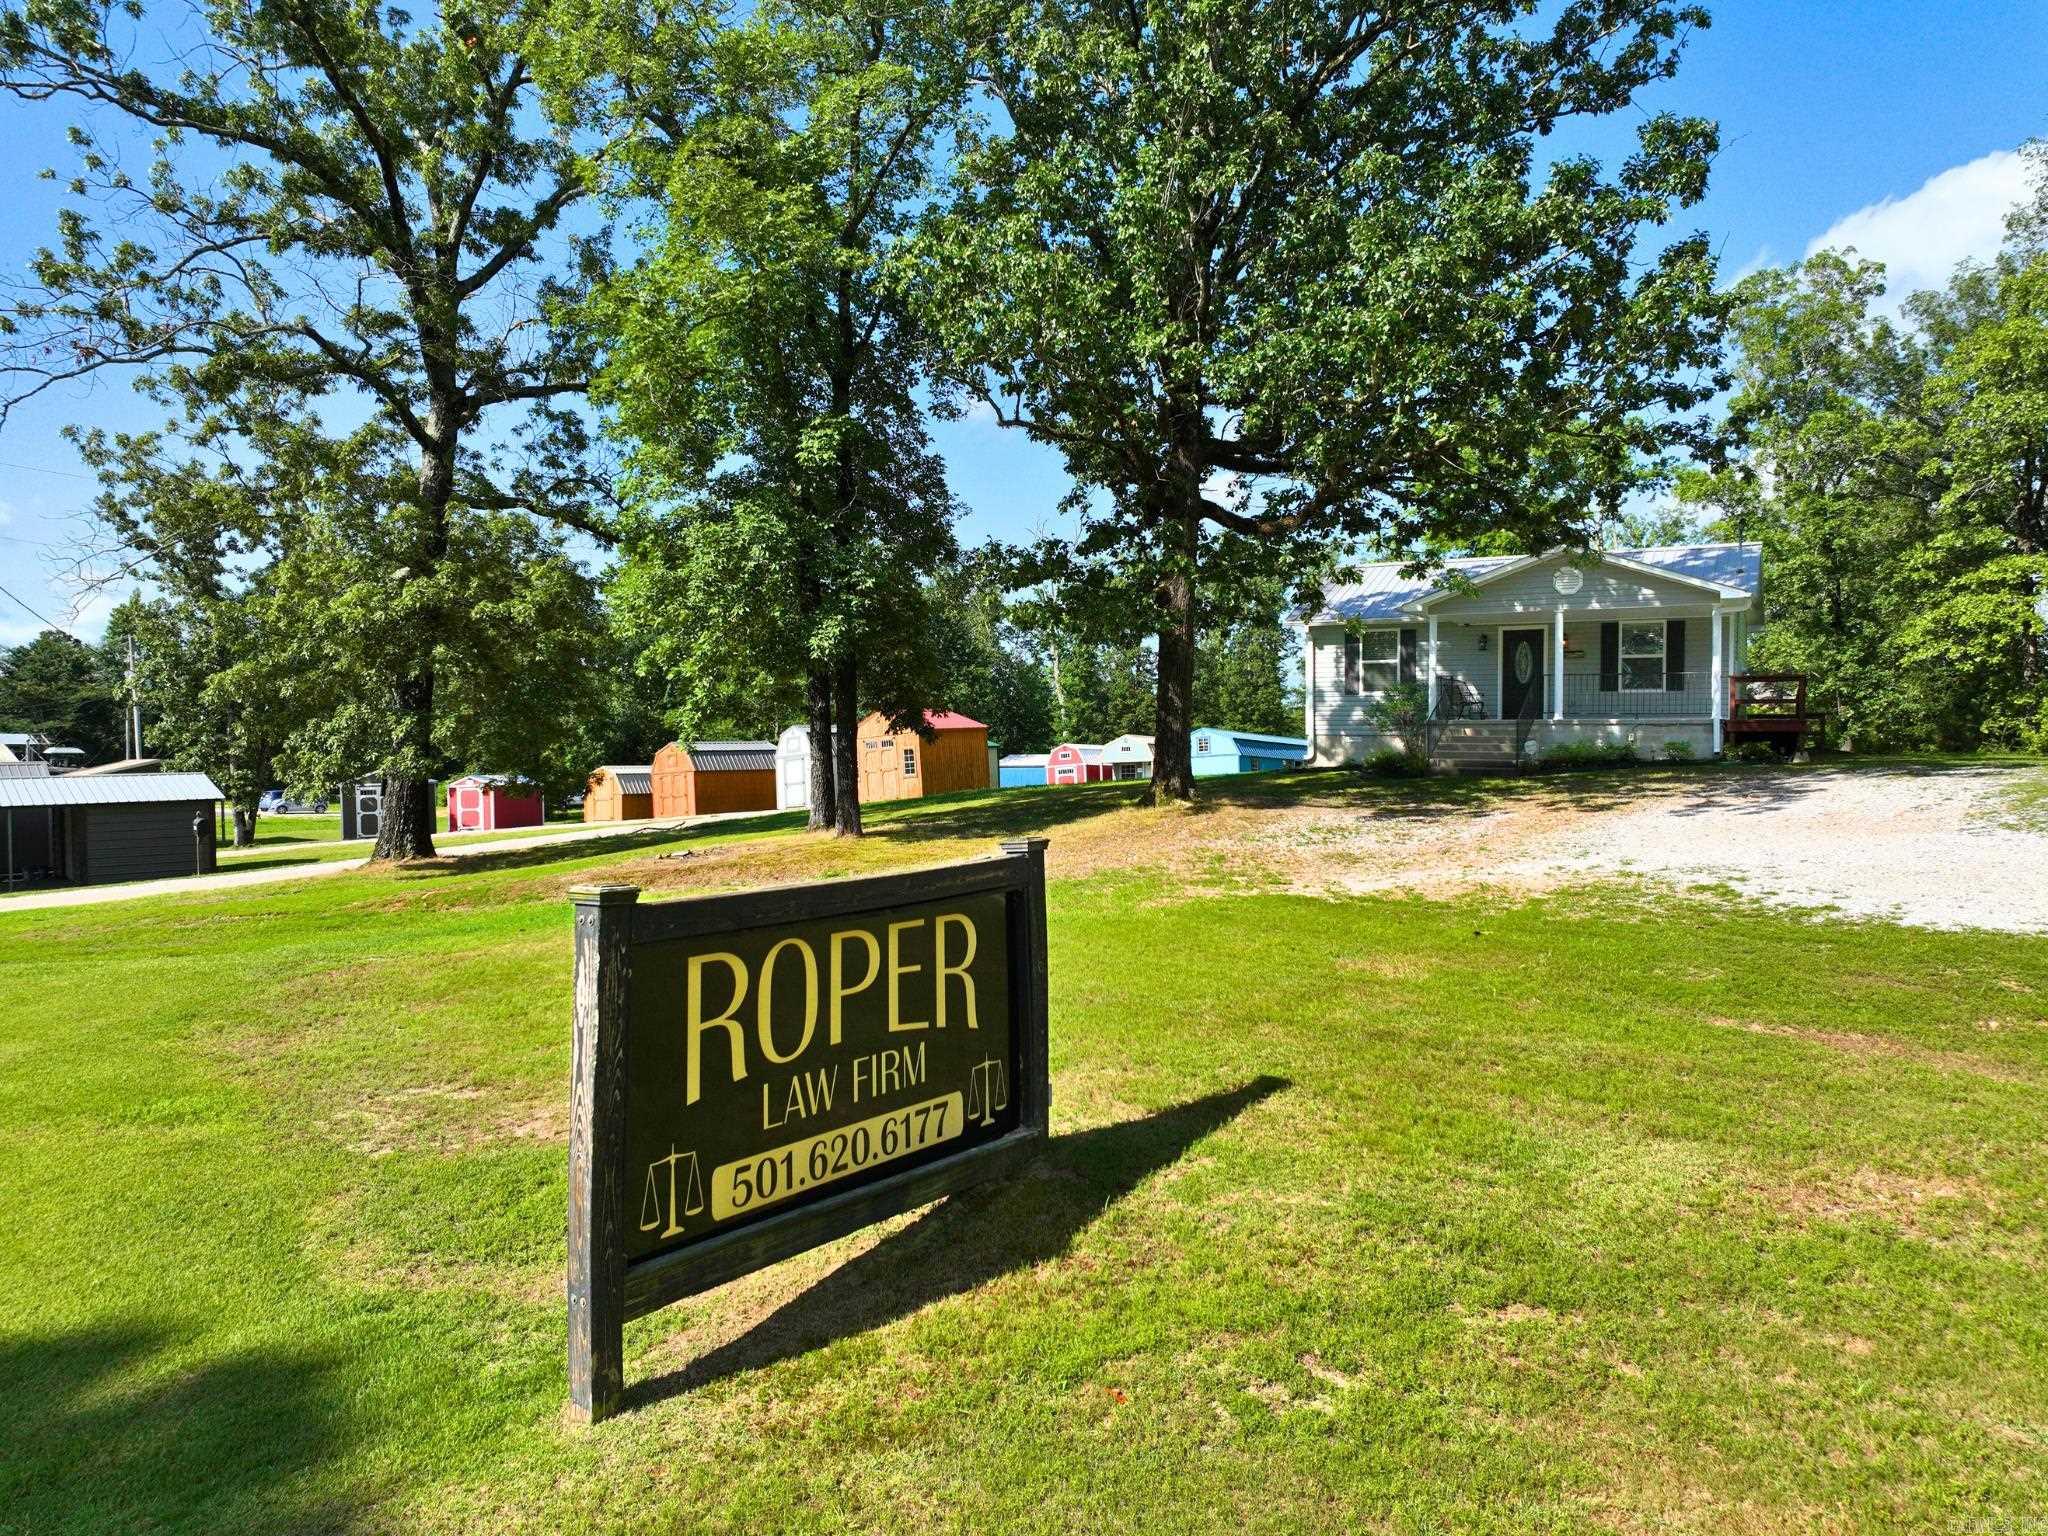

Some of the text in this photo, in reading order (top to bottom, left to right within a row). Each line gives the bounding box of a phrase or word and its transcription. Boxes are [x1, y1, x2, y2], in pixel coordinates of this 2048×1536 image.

[686, 913, 979, 1106] ROPER
[763, 1041, 926, 1131] LAW FIRM
[732, 1102, 950, 1208] 501.620.6177
